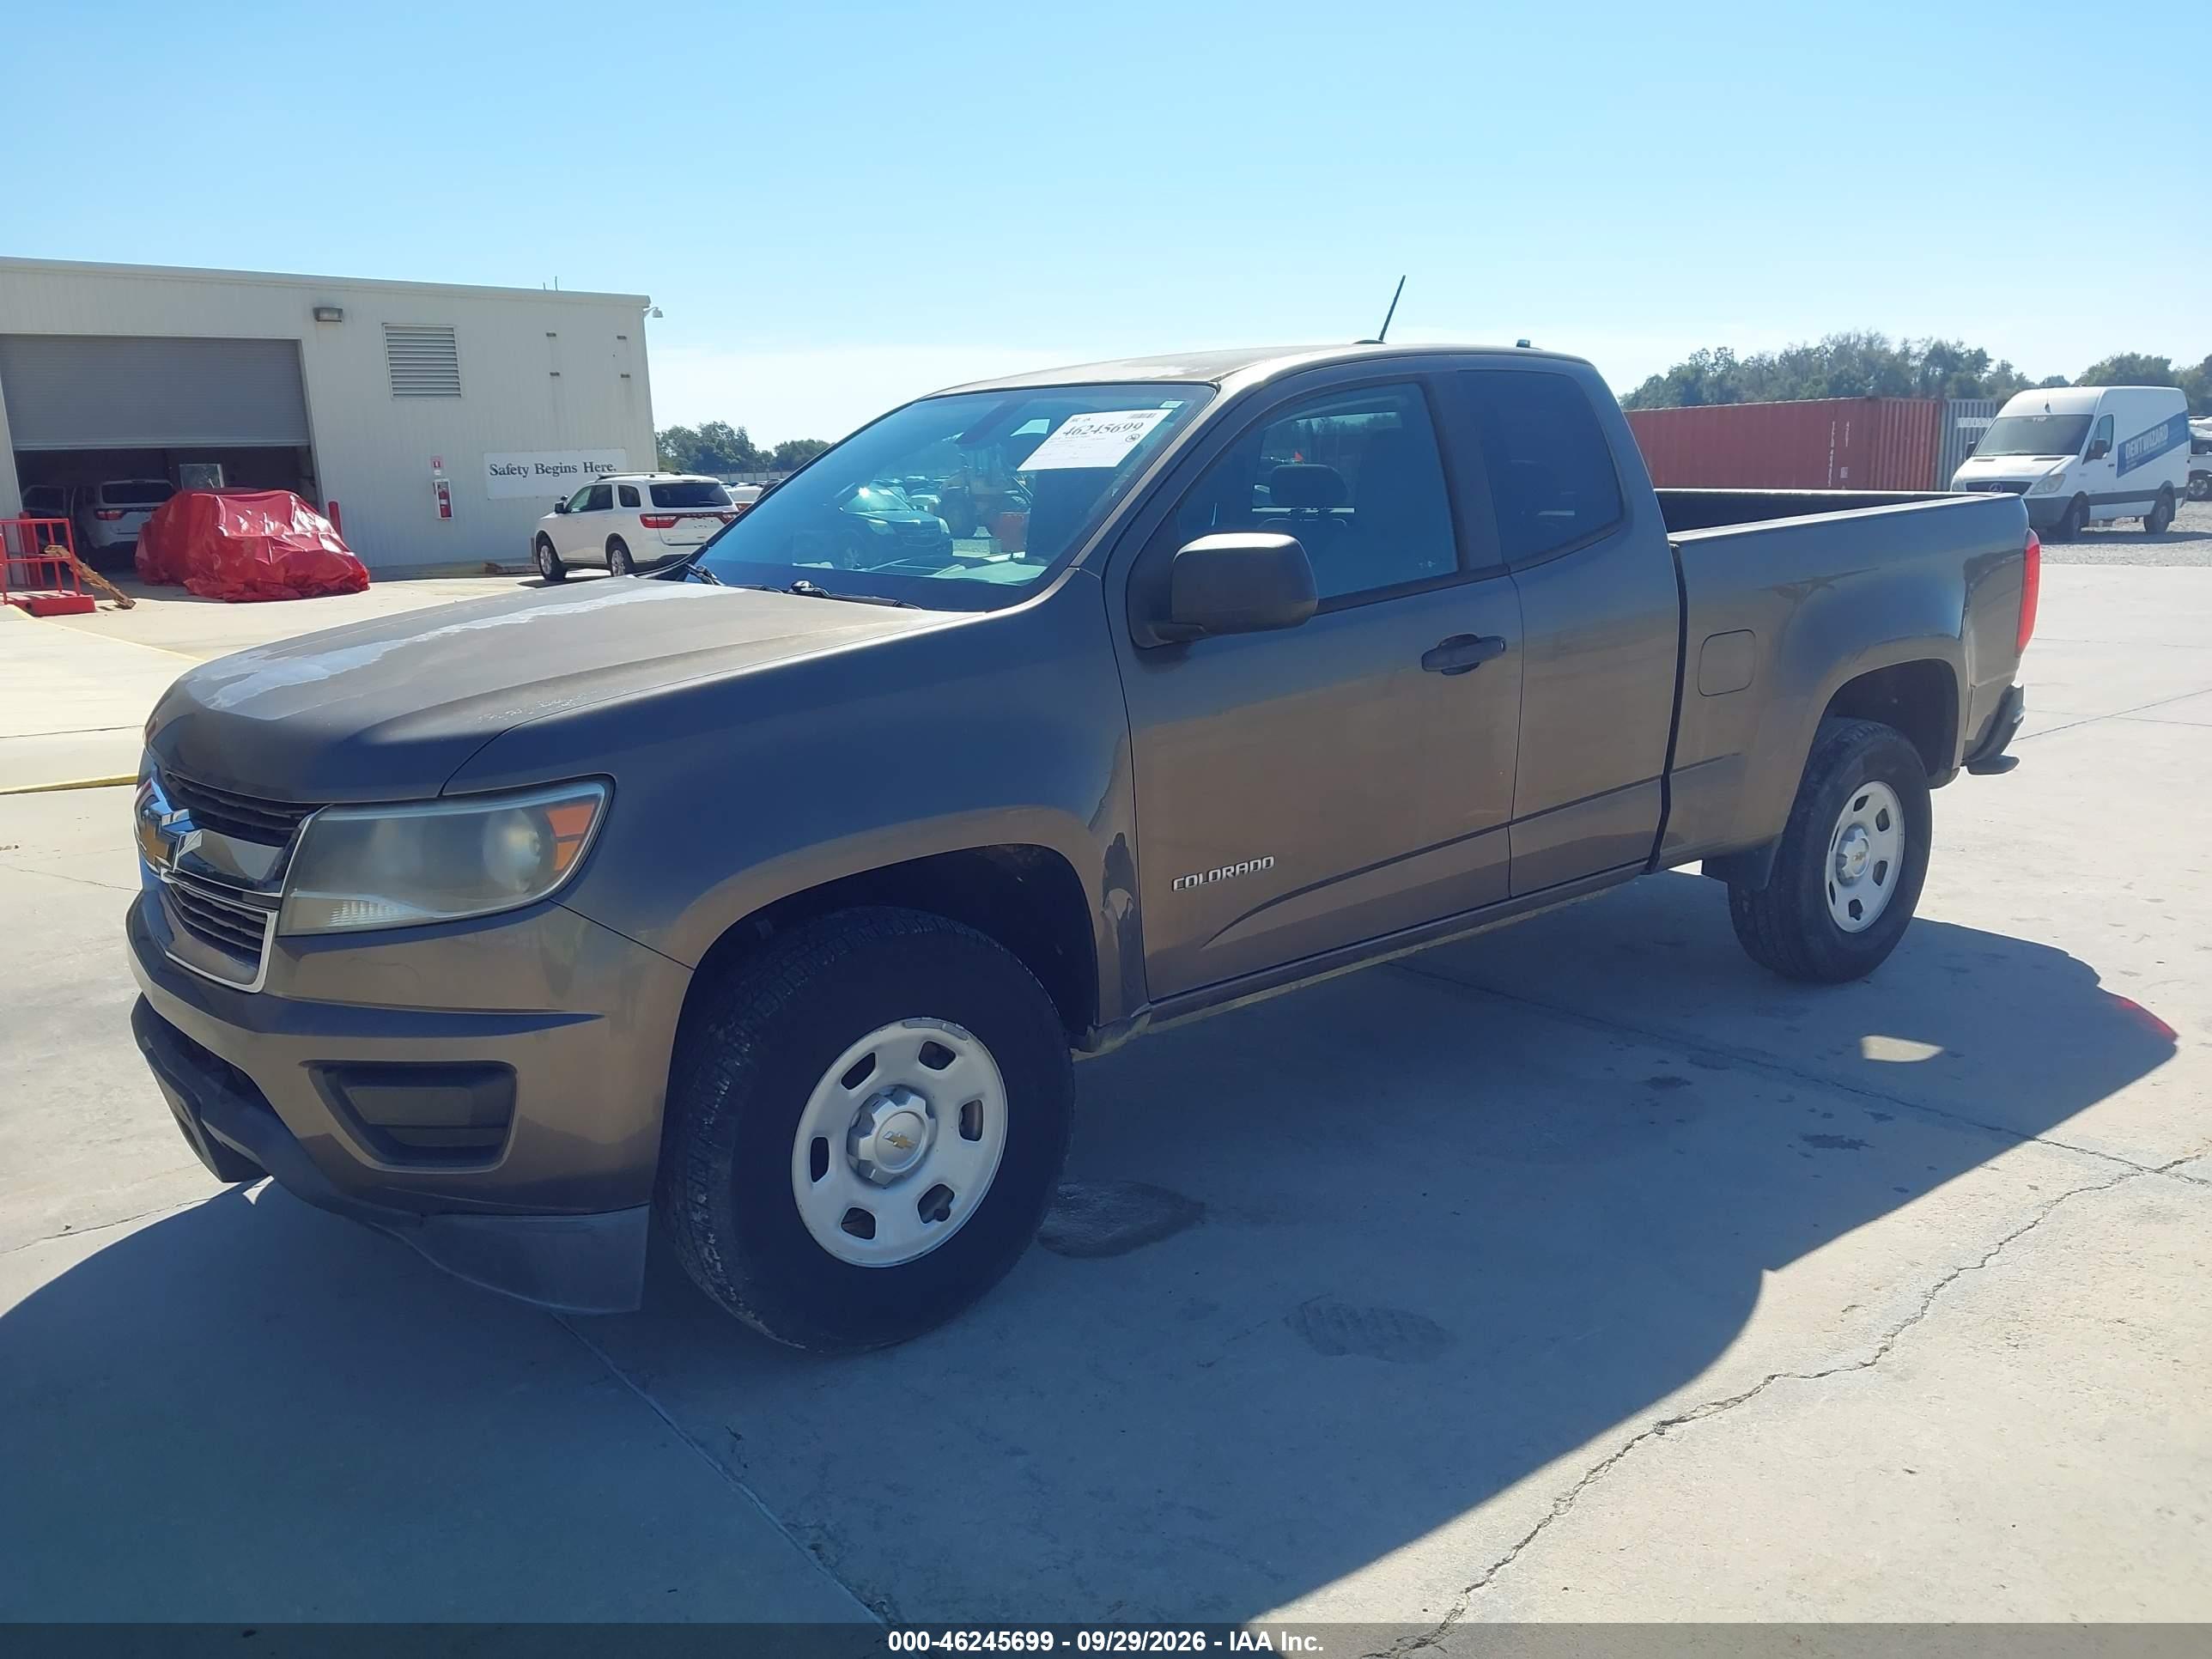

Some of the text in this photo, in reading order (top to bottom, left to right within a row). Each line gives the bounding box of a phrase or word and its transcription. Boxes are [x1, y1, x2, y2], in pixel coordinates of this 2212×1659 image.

[1063, 422, 1145, 437] 46245699
[489, 461, 617, 478] Safety Begins Here.
[1173, 856, 1274, 891] COLORADO
